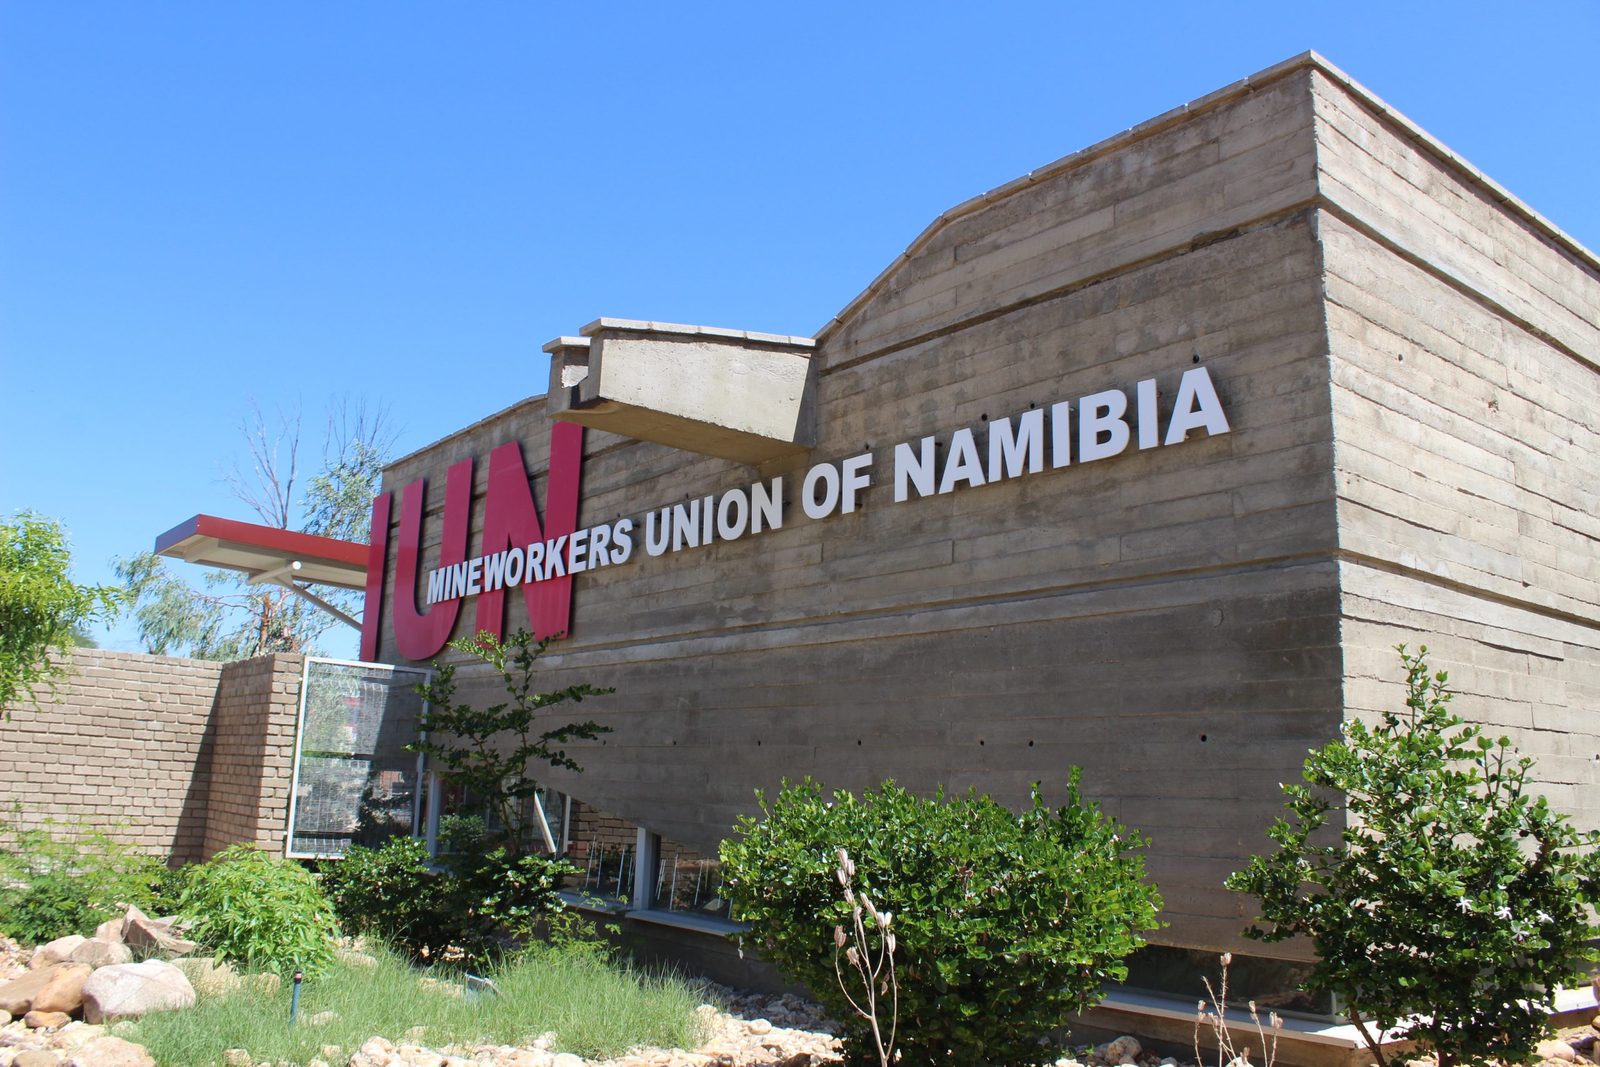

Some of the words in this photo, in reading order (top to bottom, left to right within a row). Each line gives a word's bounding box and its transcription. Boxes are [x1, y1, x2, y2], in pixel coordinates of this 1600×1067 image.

[426, 519, 633, 605] MINEWORKERS
[645, 476, 783, 557] UNION
[802, 452, 873, 520] OF
[894, 366, 1231, 502] NAMIBIA
